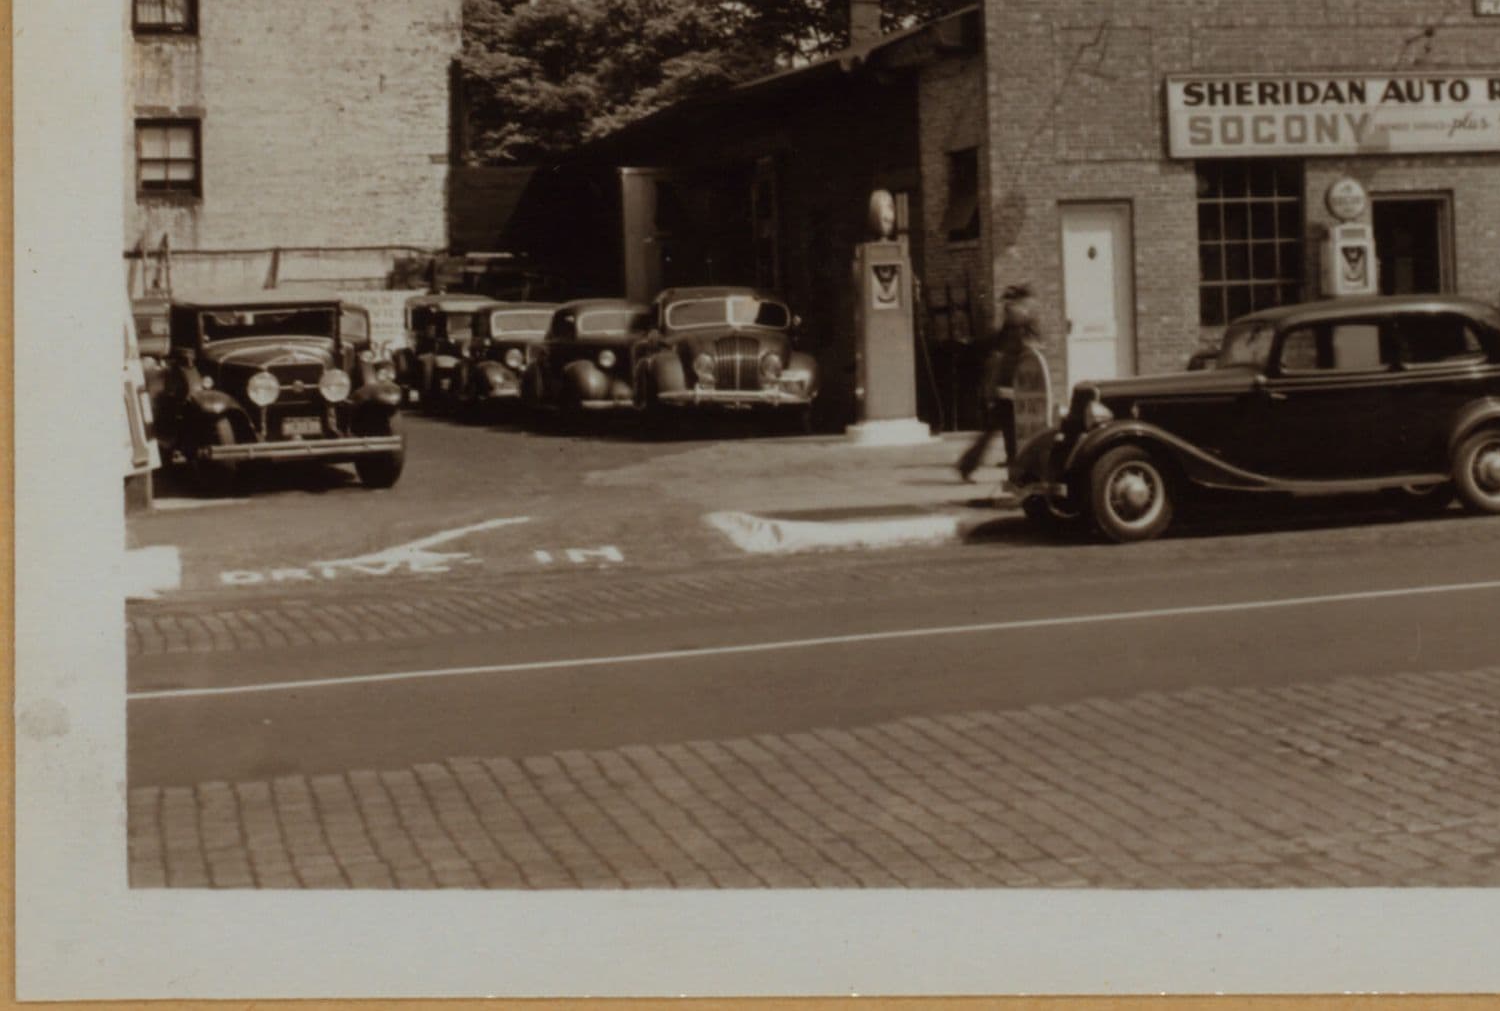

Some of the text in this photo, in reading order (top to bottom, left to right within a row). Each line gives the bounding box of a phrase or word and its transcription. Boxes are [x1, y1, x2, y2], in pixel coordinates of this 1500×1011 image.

[1183, 80, 1368, 106] SHERIDAN
[1380, 79, 1471, 103] AUTO
[1188, 111, 1490, 146] SOCONY plus
[219, 544, 625, 586] DRIVE IN
